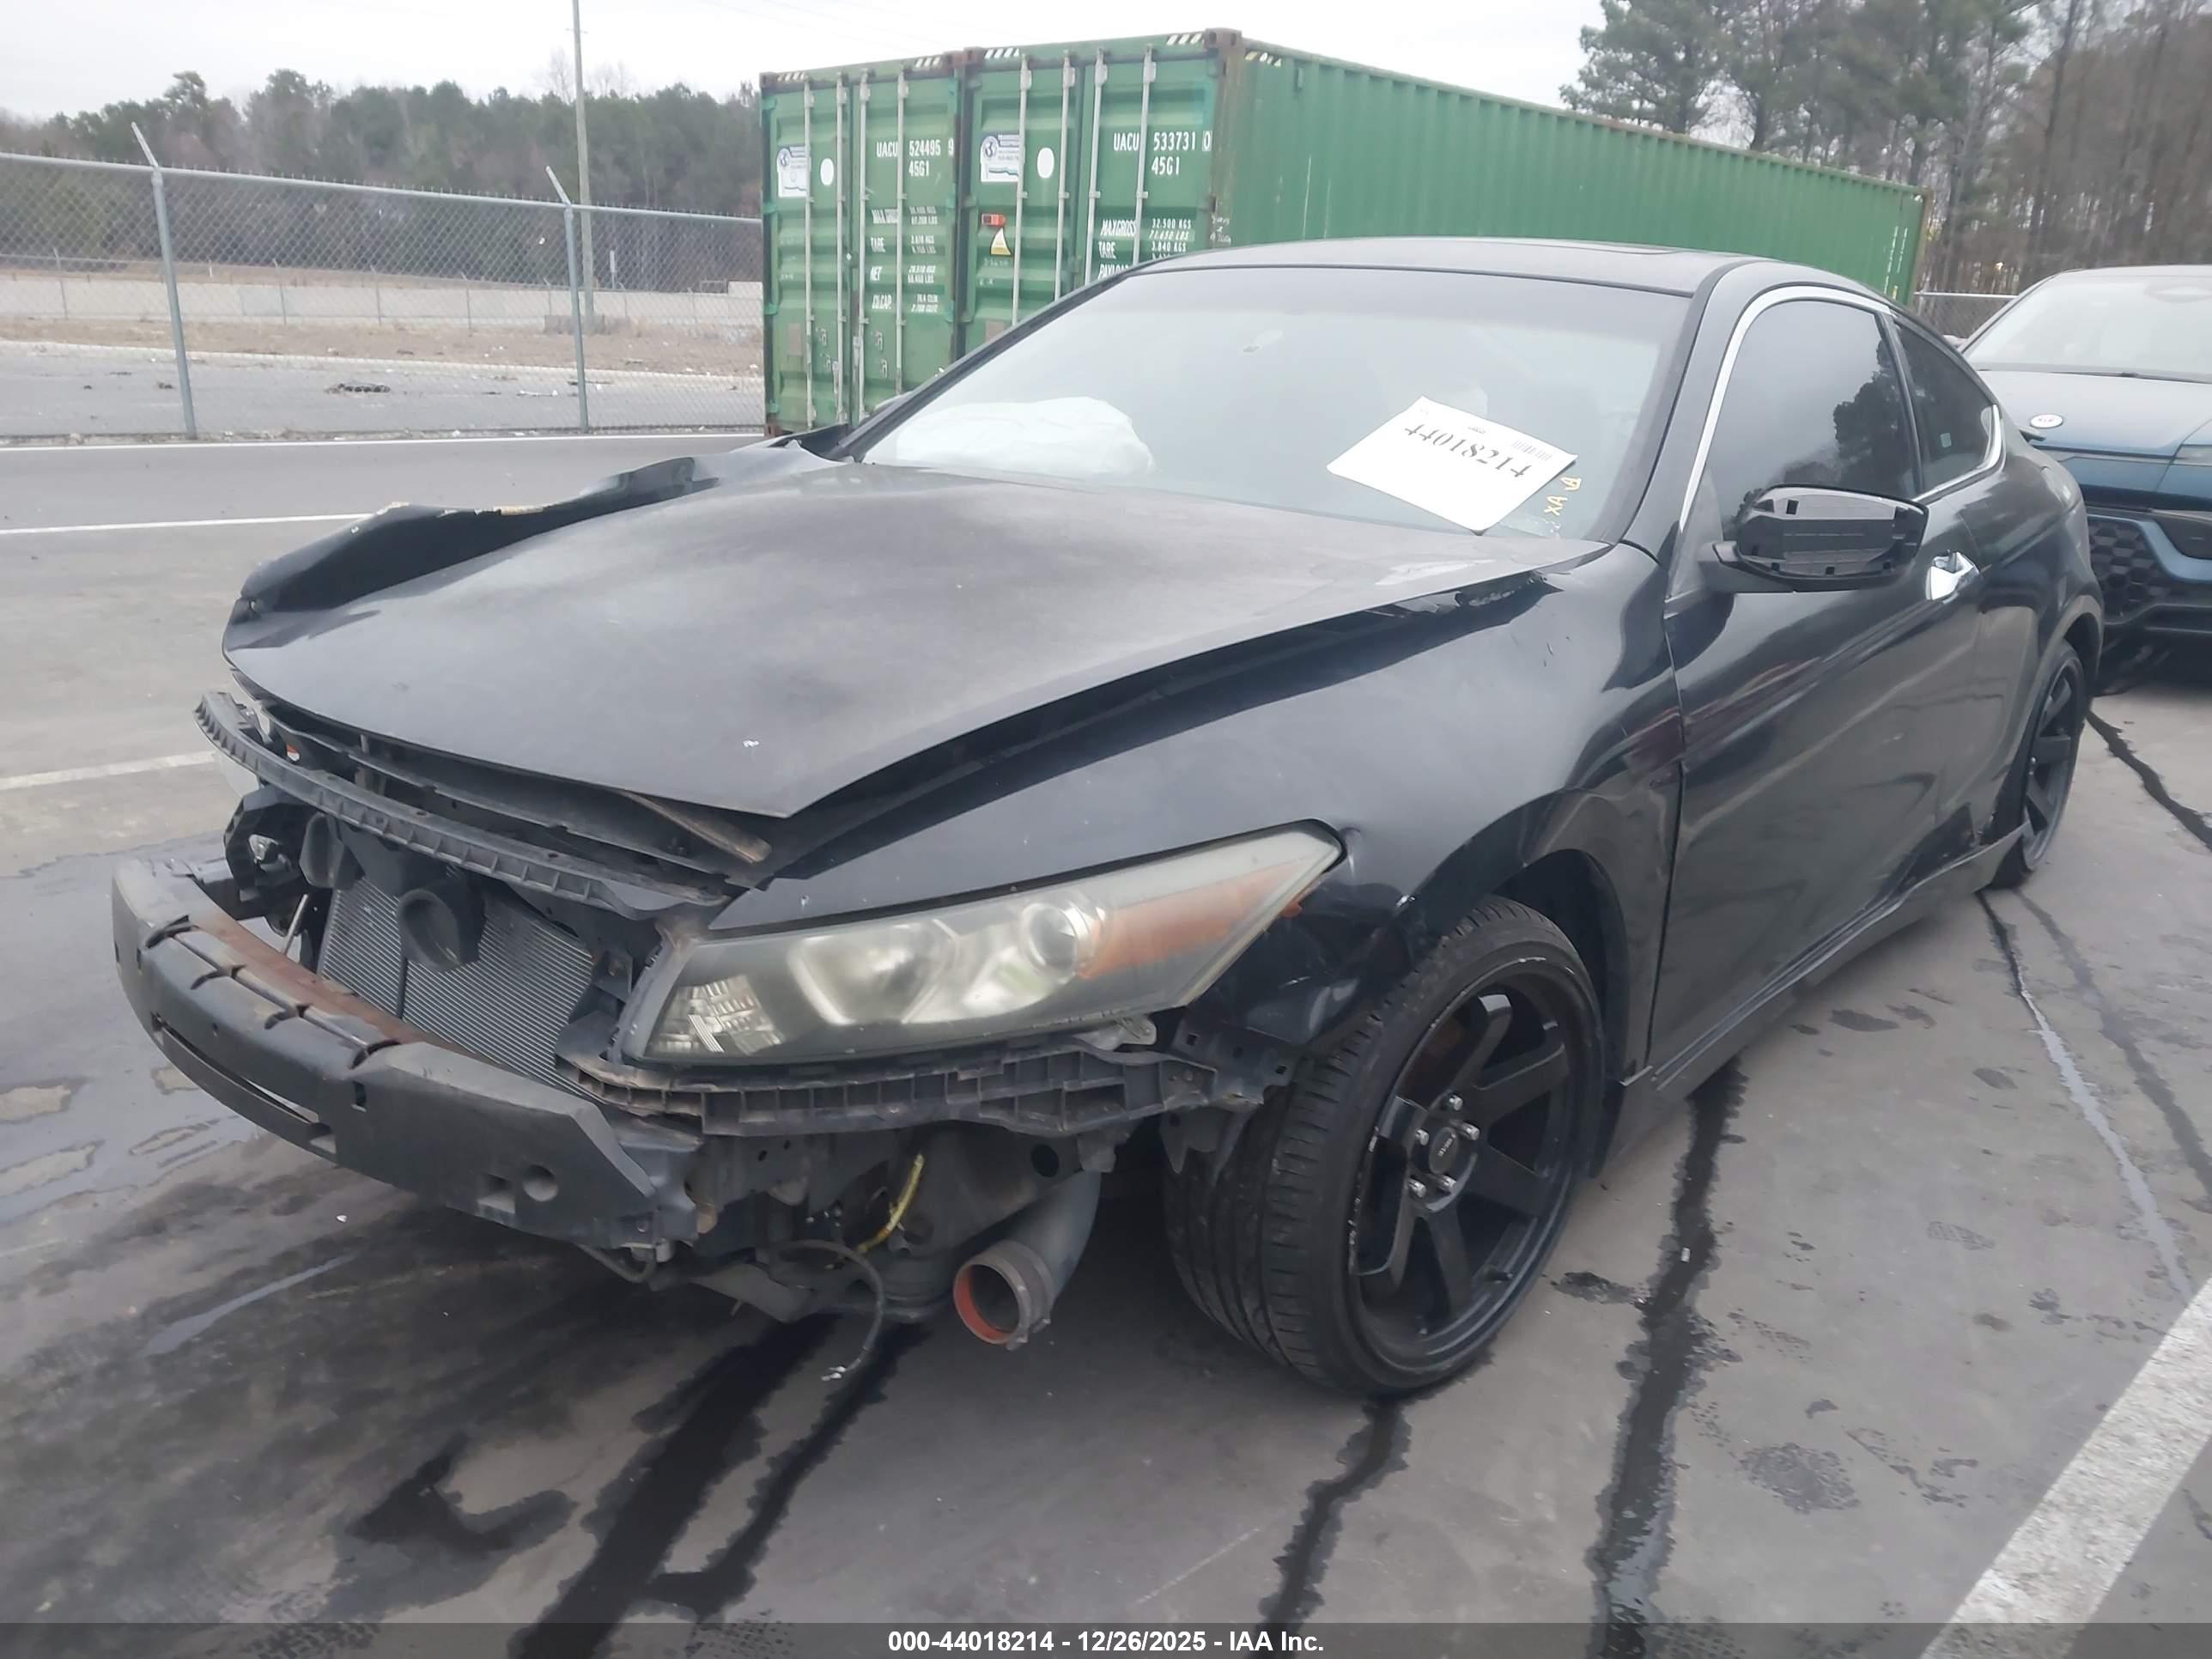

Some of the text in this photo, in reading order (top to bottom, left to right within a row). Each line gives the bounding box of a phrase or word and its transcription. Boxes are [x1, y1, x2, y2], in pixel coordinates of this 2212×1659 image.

[876, 141, 898, 157] UACU
[908, 139, 941, 156] 524495
[1112, 132, 1139, 151] UACU
[1153, 131, 1196, 151] 533731
[908, 161, 929, 177] 45G1
[1151, 156, 1180, 175] 45G1
[1098, 241, 1116, 259] TARE
[1405, 424, 1532, 477] 44018214
